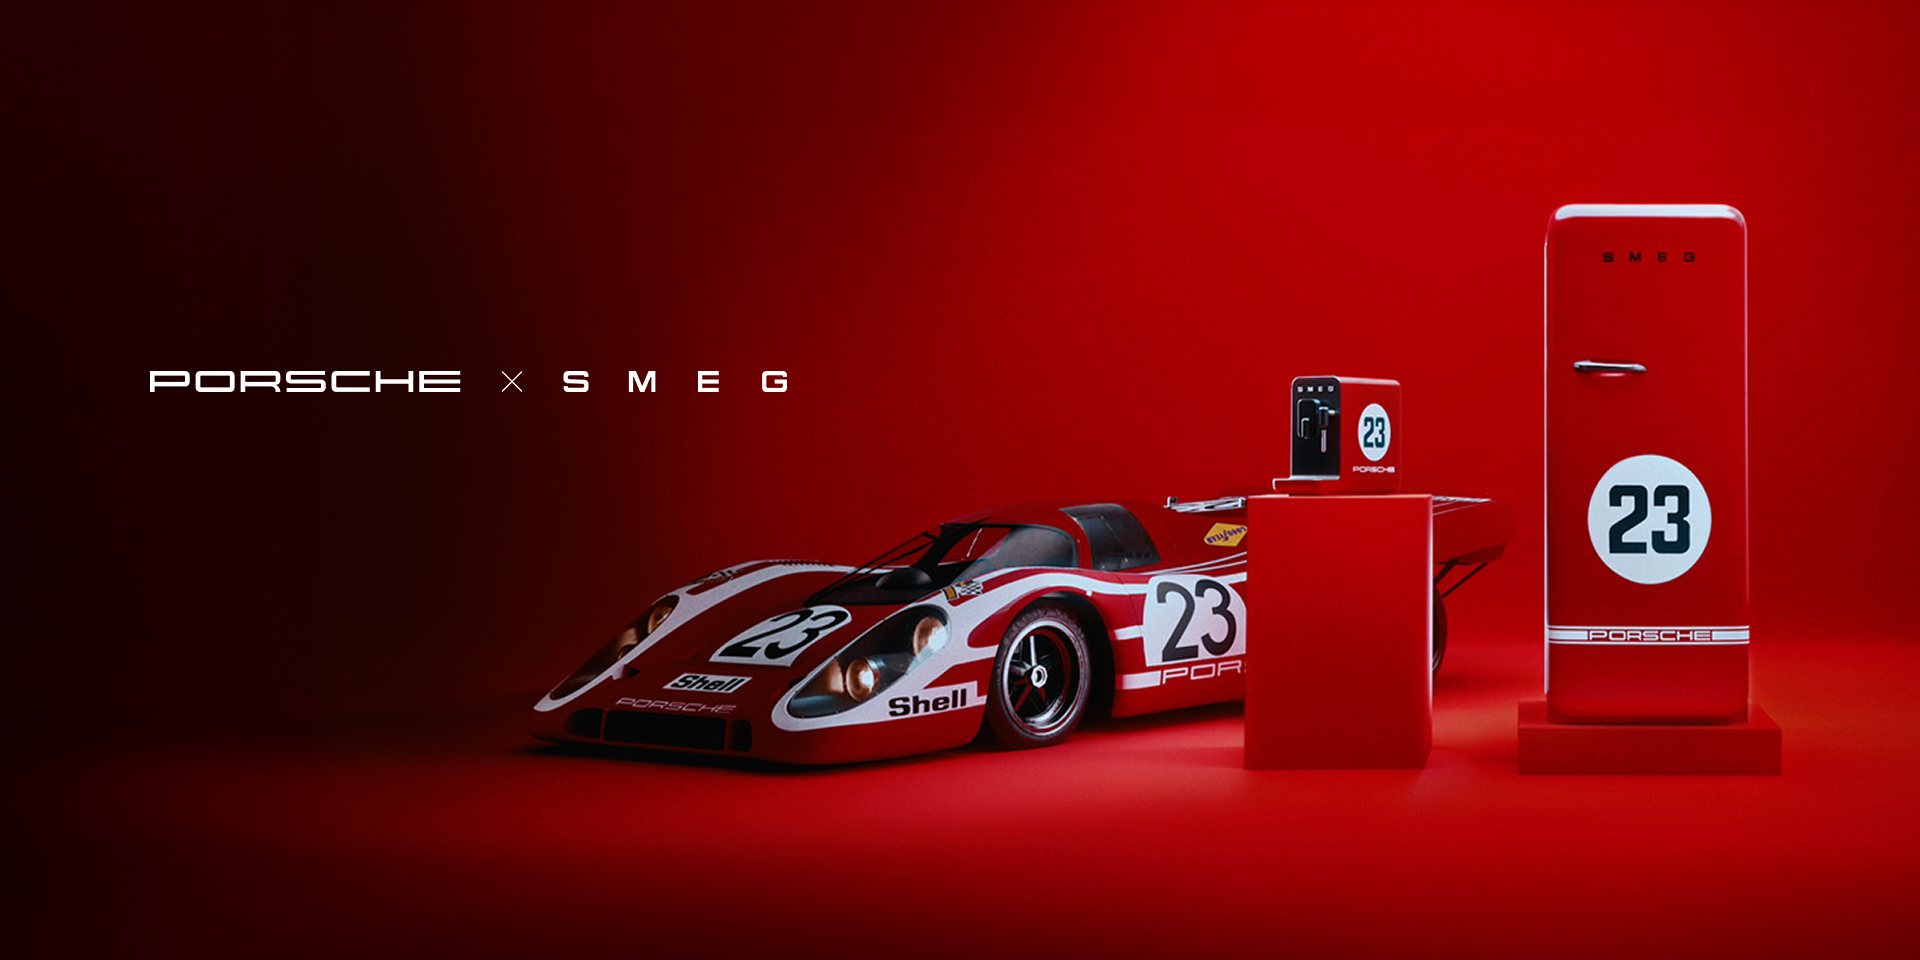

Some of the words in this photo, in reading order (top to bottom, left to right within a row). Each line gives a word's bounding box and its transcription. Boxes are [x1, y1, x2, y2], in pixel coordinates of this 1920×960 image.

[1602, 251, 1696, 263] SMEG
[1297, 385, 1335, 393] SMEG
[1363, 416, 1386, 449] 23
[1352, 465, 1396, 474] PORSCHE
[1608, 484, 1691, 555] 23
[1156, 578, 1237, 663] 23
[718, 608, 849, 660] 23
[1588, 630, 1712, 641] PORSCHE
[671, 674, 746, 692] Shell
[1161, 660, 1247, 685] POR
[614, 697, 738, 714] PORSCHE
[888, 688, 968, 718] Shell
